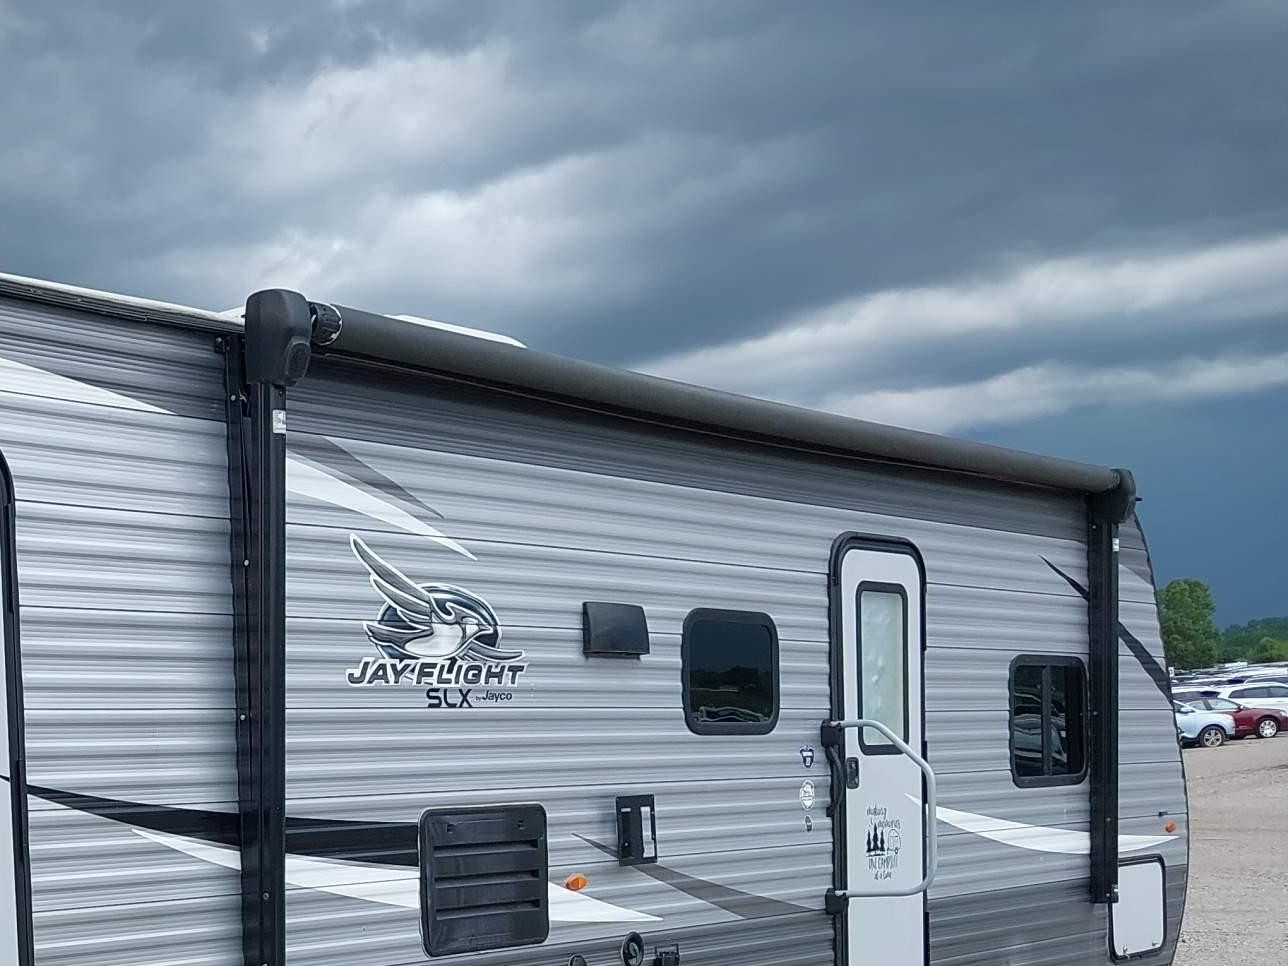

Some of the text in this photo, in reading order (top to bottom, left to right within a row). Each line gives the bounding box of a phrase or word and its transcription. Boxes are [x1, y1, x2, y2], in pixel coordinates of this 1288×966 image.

[345, 658, 525, 686] JAY FLIGHT
[426, 688, 472, 708] SLX
[482, 689, 513, 703] Jayco
